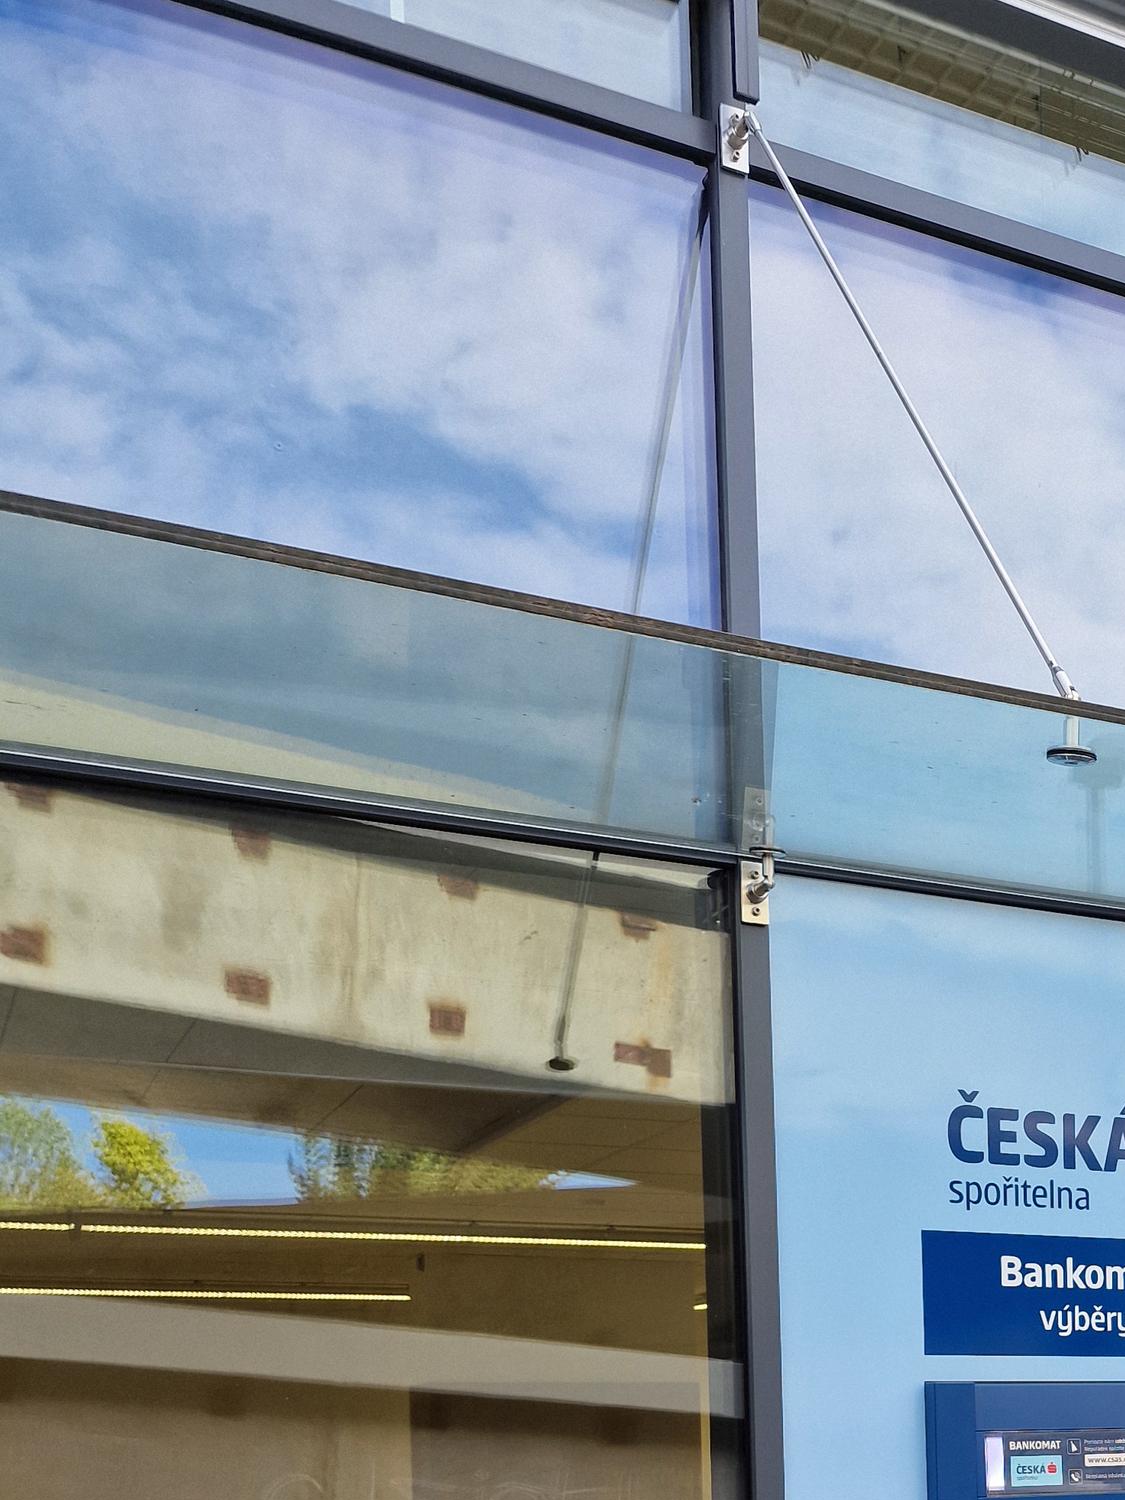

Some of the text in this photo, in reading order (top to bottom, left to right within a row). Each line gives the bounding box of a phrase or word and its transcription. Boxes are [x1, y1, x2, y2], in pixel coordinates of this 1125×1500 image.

[949, 1175, 1090, 1211] spořitelna
[1009, 1440, 1062, 1451] BANKOMAT
[1016, 1463, 1046, 1475] ČESKÁ
